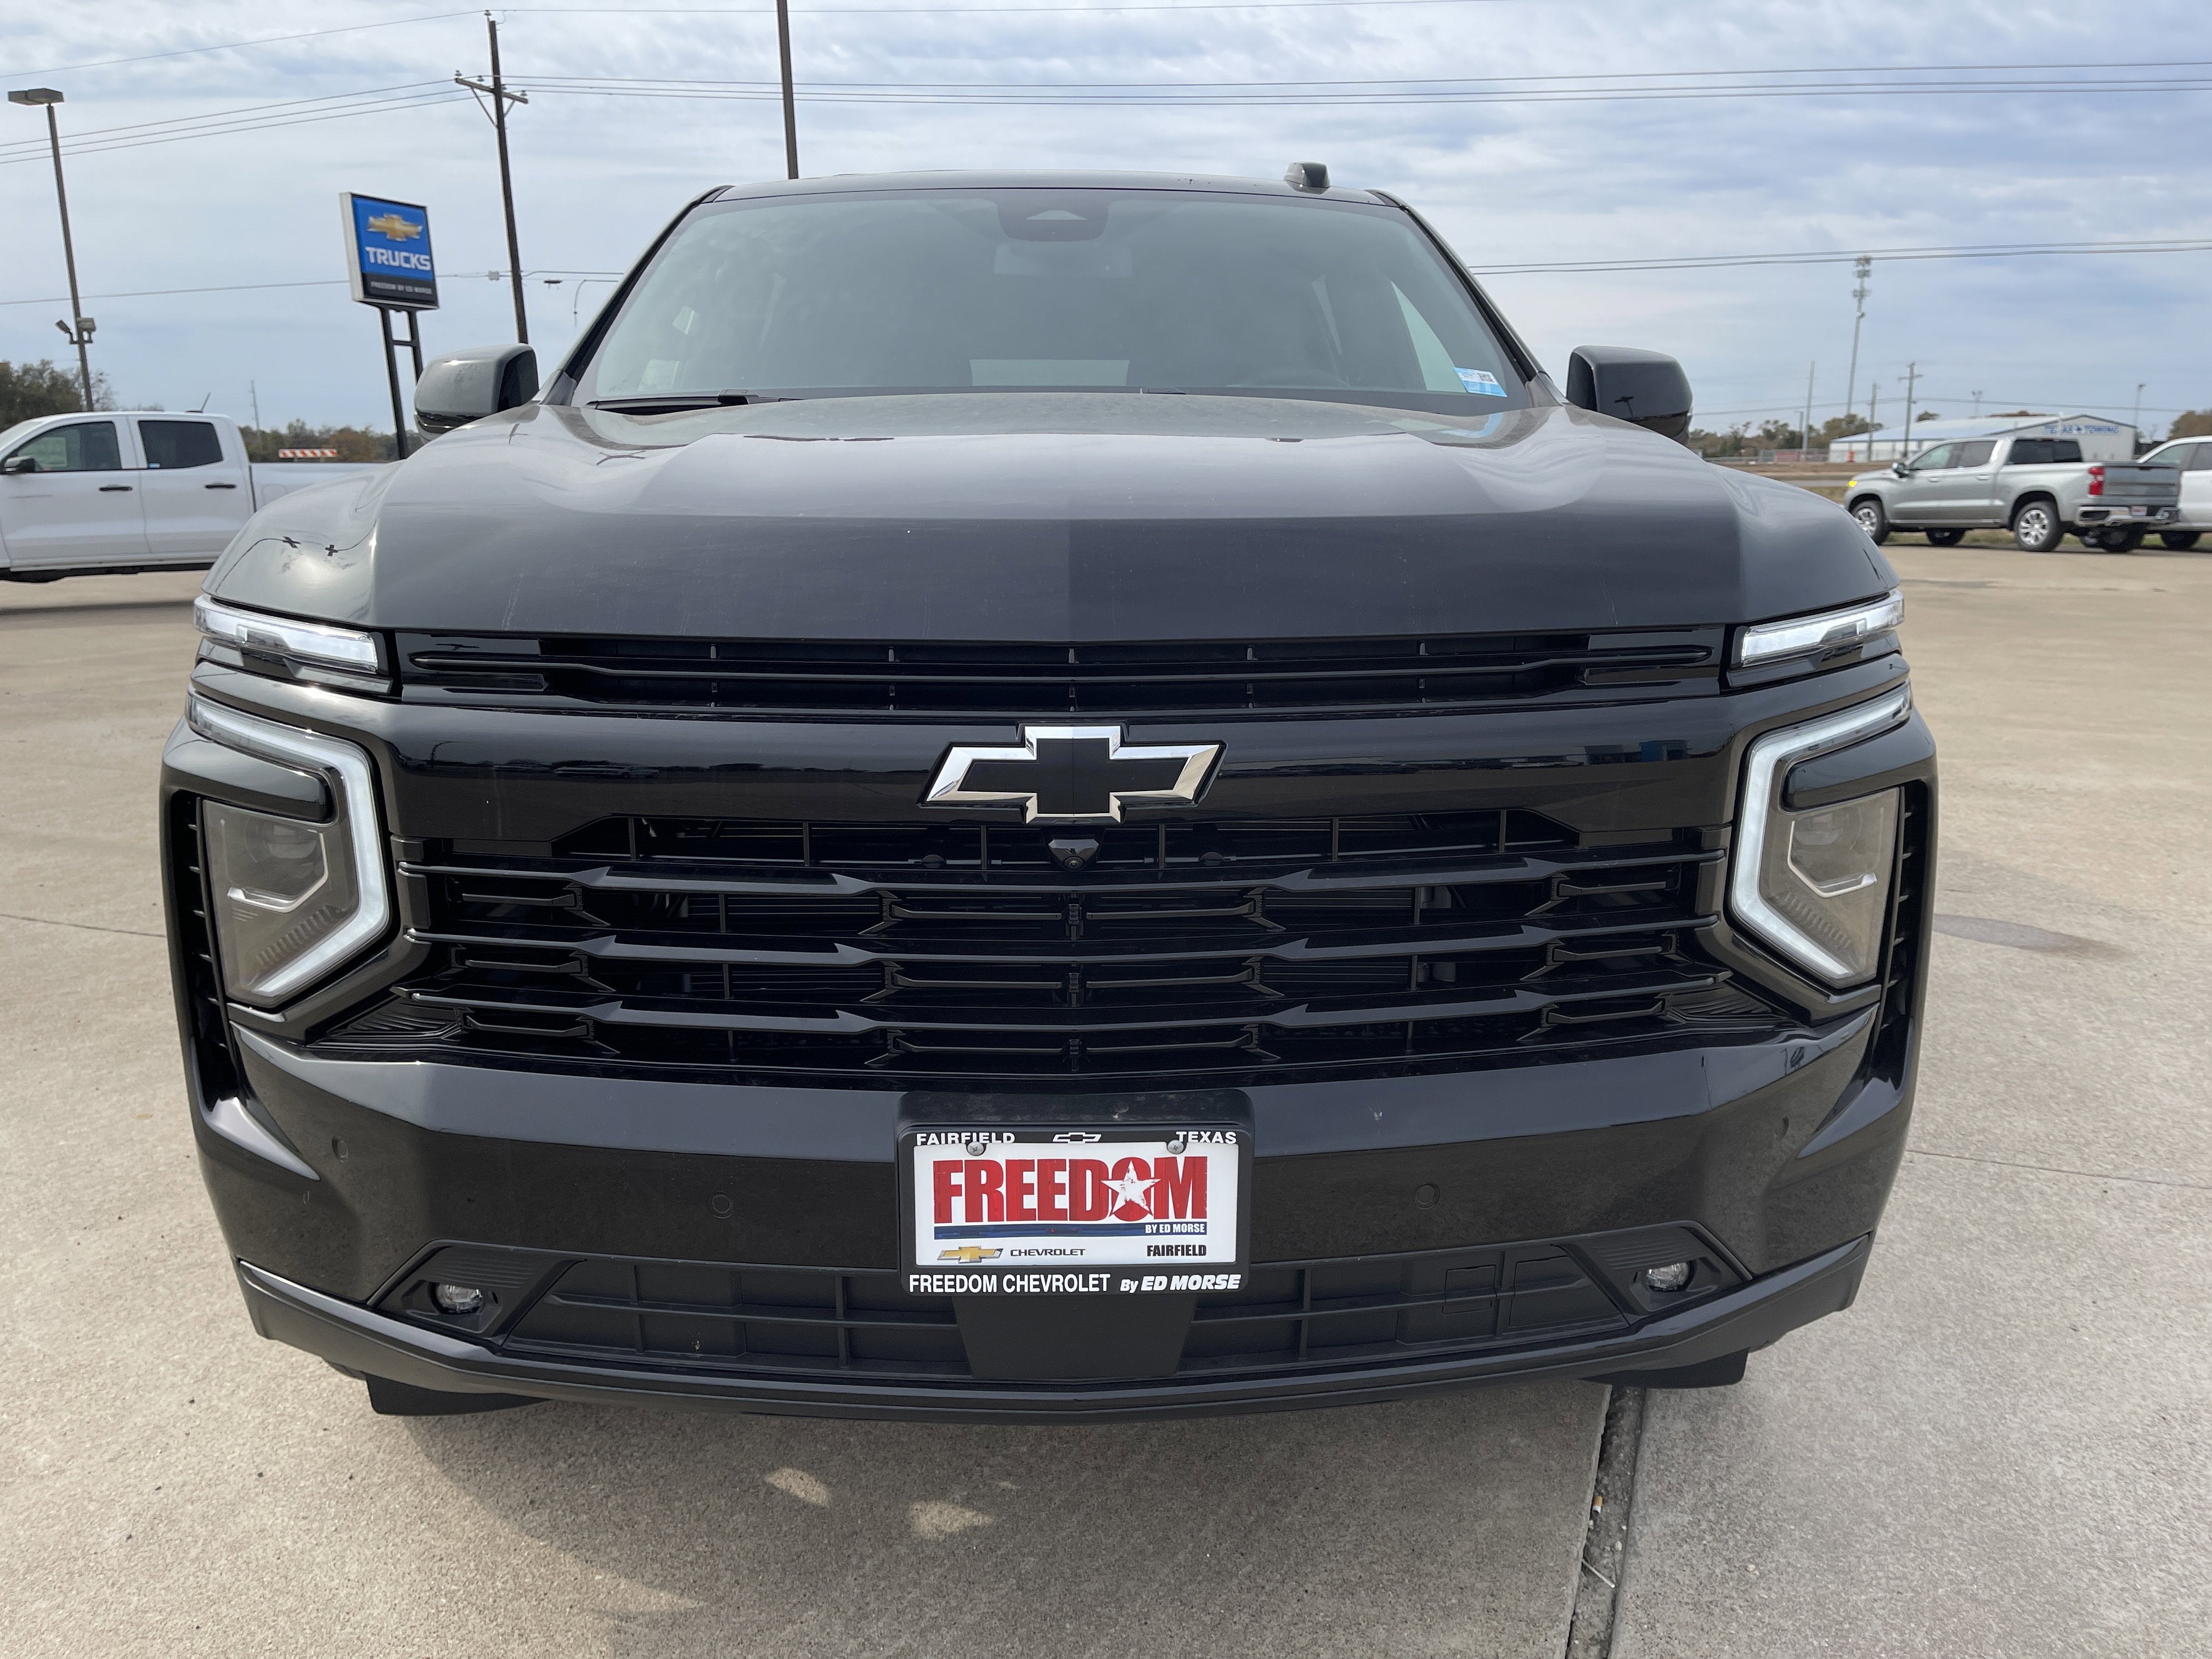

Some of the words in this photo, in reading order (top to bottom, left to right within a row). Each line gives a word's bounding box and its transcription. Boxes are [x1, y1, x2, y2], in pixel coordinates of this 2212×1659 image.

[365, 246, 431, 271] TRUCKS
[916, 1132, 1015, 1146] FAIRFIELD
[1176, 1131, 1237, 1144] TEXAS
[933, 1156, 1207, 1224] FREEDOM
[1145, 1224, 1158, 1234] BY
[1159, 1223, 1171, 1233] ED
[1172, 1223, 1205, 1233] MORSE
[1010, 1249, 1086, 1257] CHEVROLET
[1147, 1244, 1207, 1257] FAIRFIELD
[909, 1274, 997, 1294] FREEDOM
[1002, 1273, 1111, 1293] CHEVROLET
[1120, 1279, 1139, 1294] By
[1141, 1276, 1168, 1291] ED
[1170, 1274, 1242, 1290] MORSE
